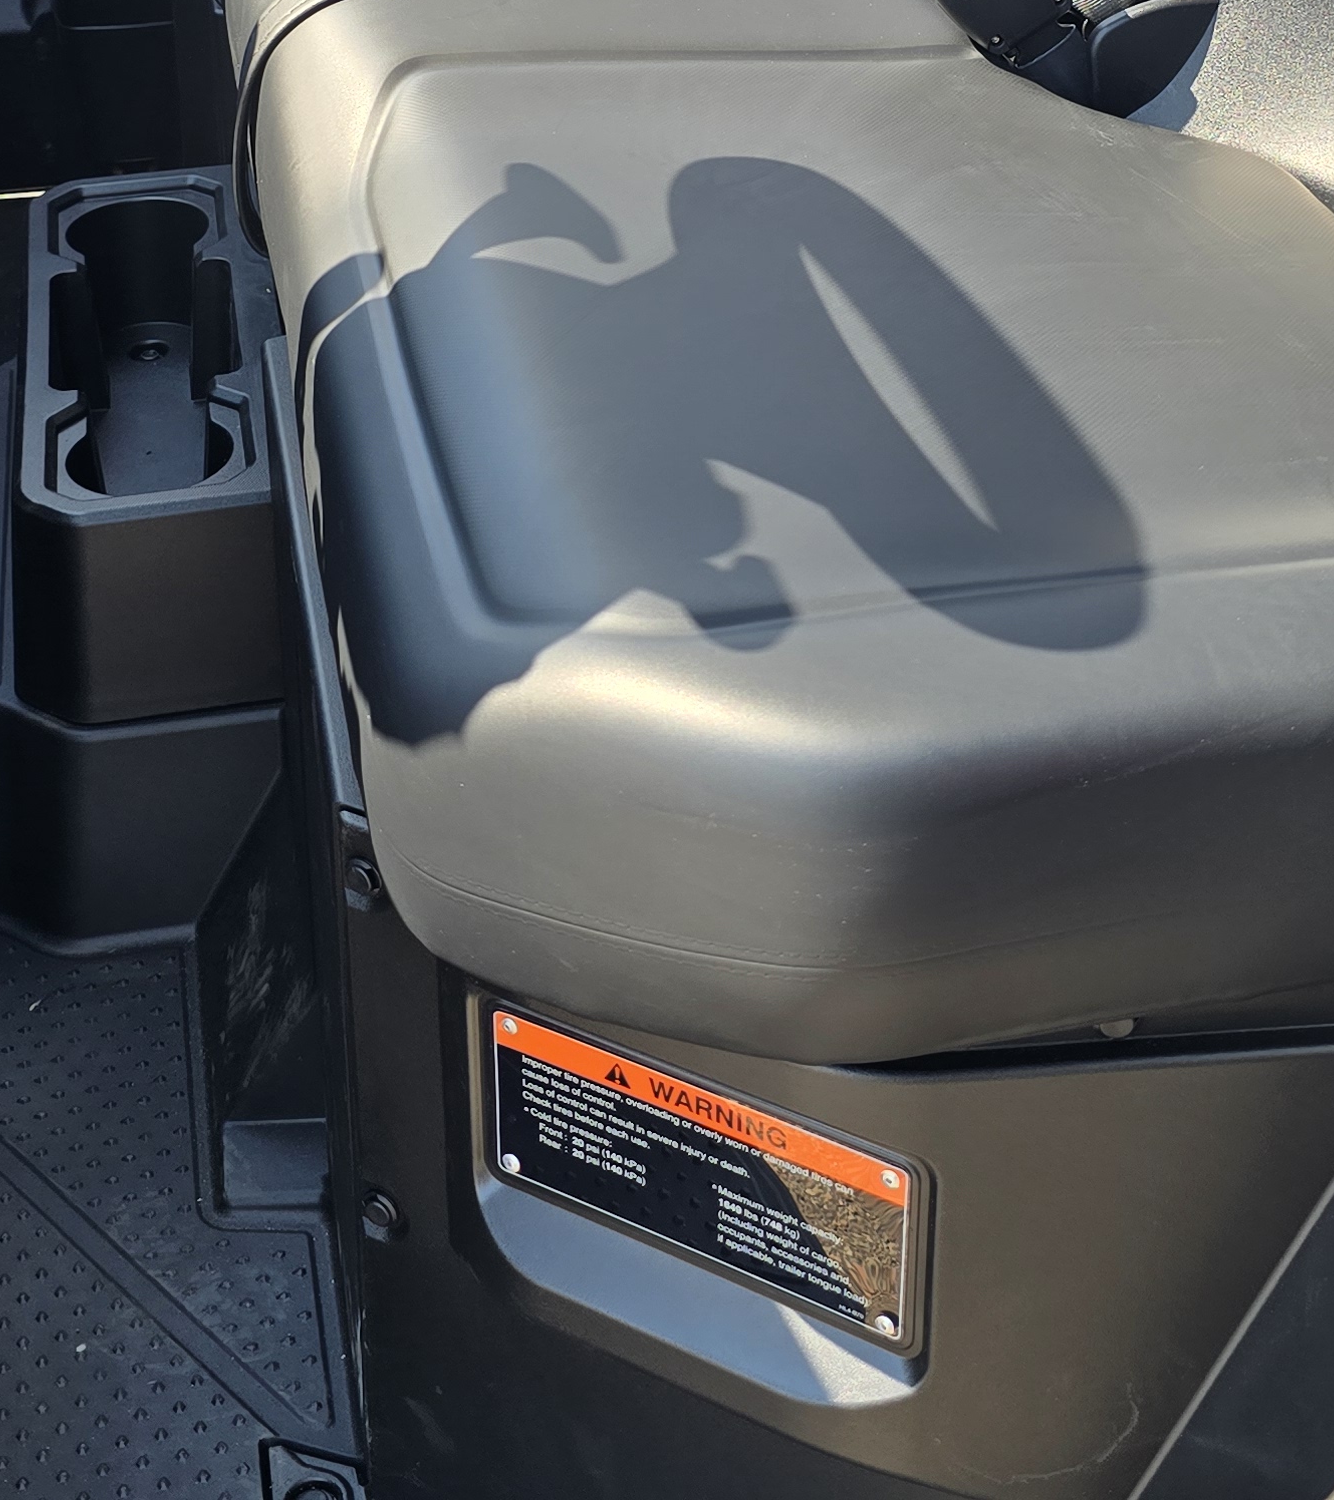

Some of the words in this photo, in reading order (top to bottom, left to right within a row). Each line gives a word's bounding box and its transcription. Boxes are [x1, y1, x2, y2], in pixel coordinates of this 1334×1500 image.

[521, 1068, 549, 1084] cause
[550, 1077, 570, 1092] loss
[571, 1087, 581, 1096] of
[582, 1092, 616, 1111] control.
[648, 1076, 787, 1151] WARNING
[521, 1054, 562, 1077] Improper
[563, 1072, 579, 1084] tire
[580, 1079, 623, 1102] pressure,
[625, 1097, 679, 1126] overloading
[681, 1120, 691, 1129] or
[693, 1124, 722, 1143] overly
[724, 1137, 748, 1152] worn
[750, 1148, 761, 1157] or
[762, 1150, 809, 1179] damaged
[834, 1181, 854, 1196] can
[522, 1090, 551, 1108] Check
[552, 1103, 573, 1117] tires
[574, 1111, 604, 1129] before
[605, 1125, 628, 1140] each
[630, 1135, 650, 1149] use.
[522, 1078, 544, 1094] Loss
[545, 1089, 555, 1098] of
[556, 1093, 587, 1111] control
[589, 1107, 606, 1119] can
[608, 1114, 634, 1130] result
[635, 1124, 645, 1134] in
[646, 1130, 678, 1148] severe
[680, 1142, 706, 1161] injury
[707, 1155, 718, 1164] or
[719, 1160, 750, 1178] death.
[530, 1107, 551, 1122] Cold
[553, 1116, 568, 1129] tire
[569, 1124, 612, 1147] pressure:
[571, 1136, 584, 1147] 20
[585, 1143, 599, 1154] psi
[601, 1148, 622, 1163] (140
[623, 1157, 645, 1174] kPa)
[572, 1147, 584, 1159] 20
[585, 1154, 600, 1165] psi
[601, 1160, 622, 1175] (140
[623, 1169, 645, 1186] kPa)
[717, 1184, 764, 1211] Maximum
[765, 1207, 798, 1226] weight
[799, 1219, 844, 1248] capacity:
[743, 1208, 758, 1221] lbs
[783, 1225, 799, 1240] kg)
[716, 1222, 768, 1251] occupants,
[770, 1245, 828, 1275] accessories
[725, 1238, 775, 1266] applicable,
[778, 1260, 806, 1277] trailer
[807, 1272, 841, 1293] tongue
[765, 1231, 797, 1250] weight
[799, 1246, 809, 1255] of
